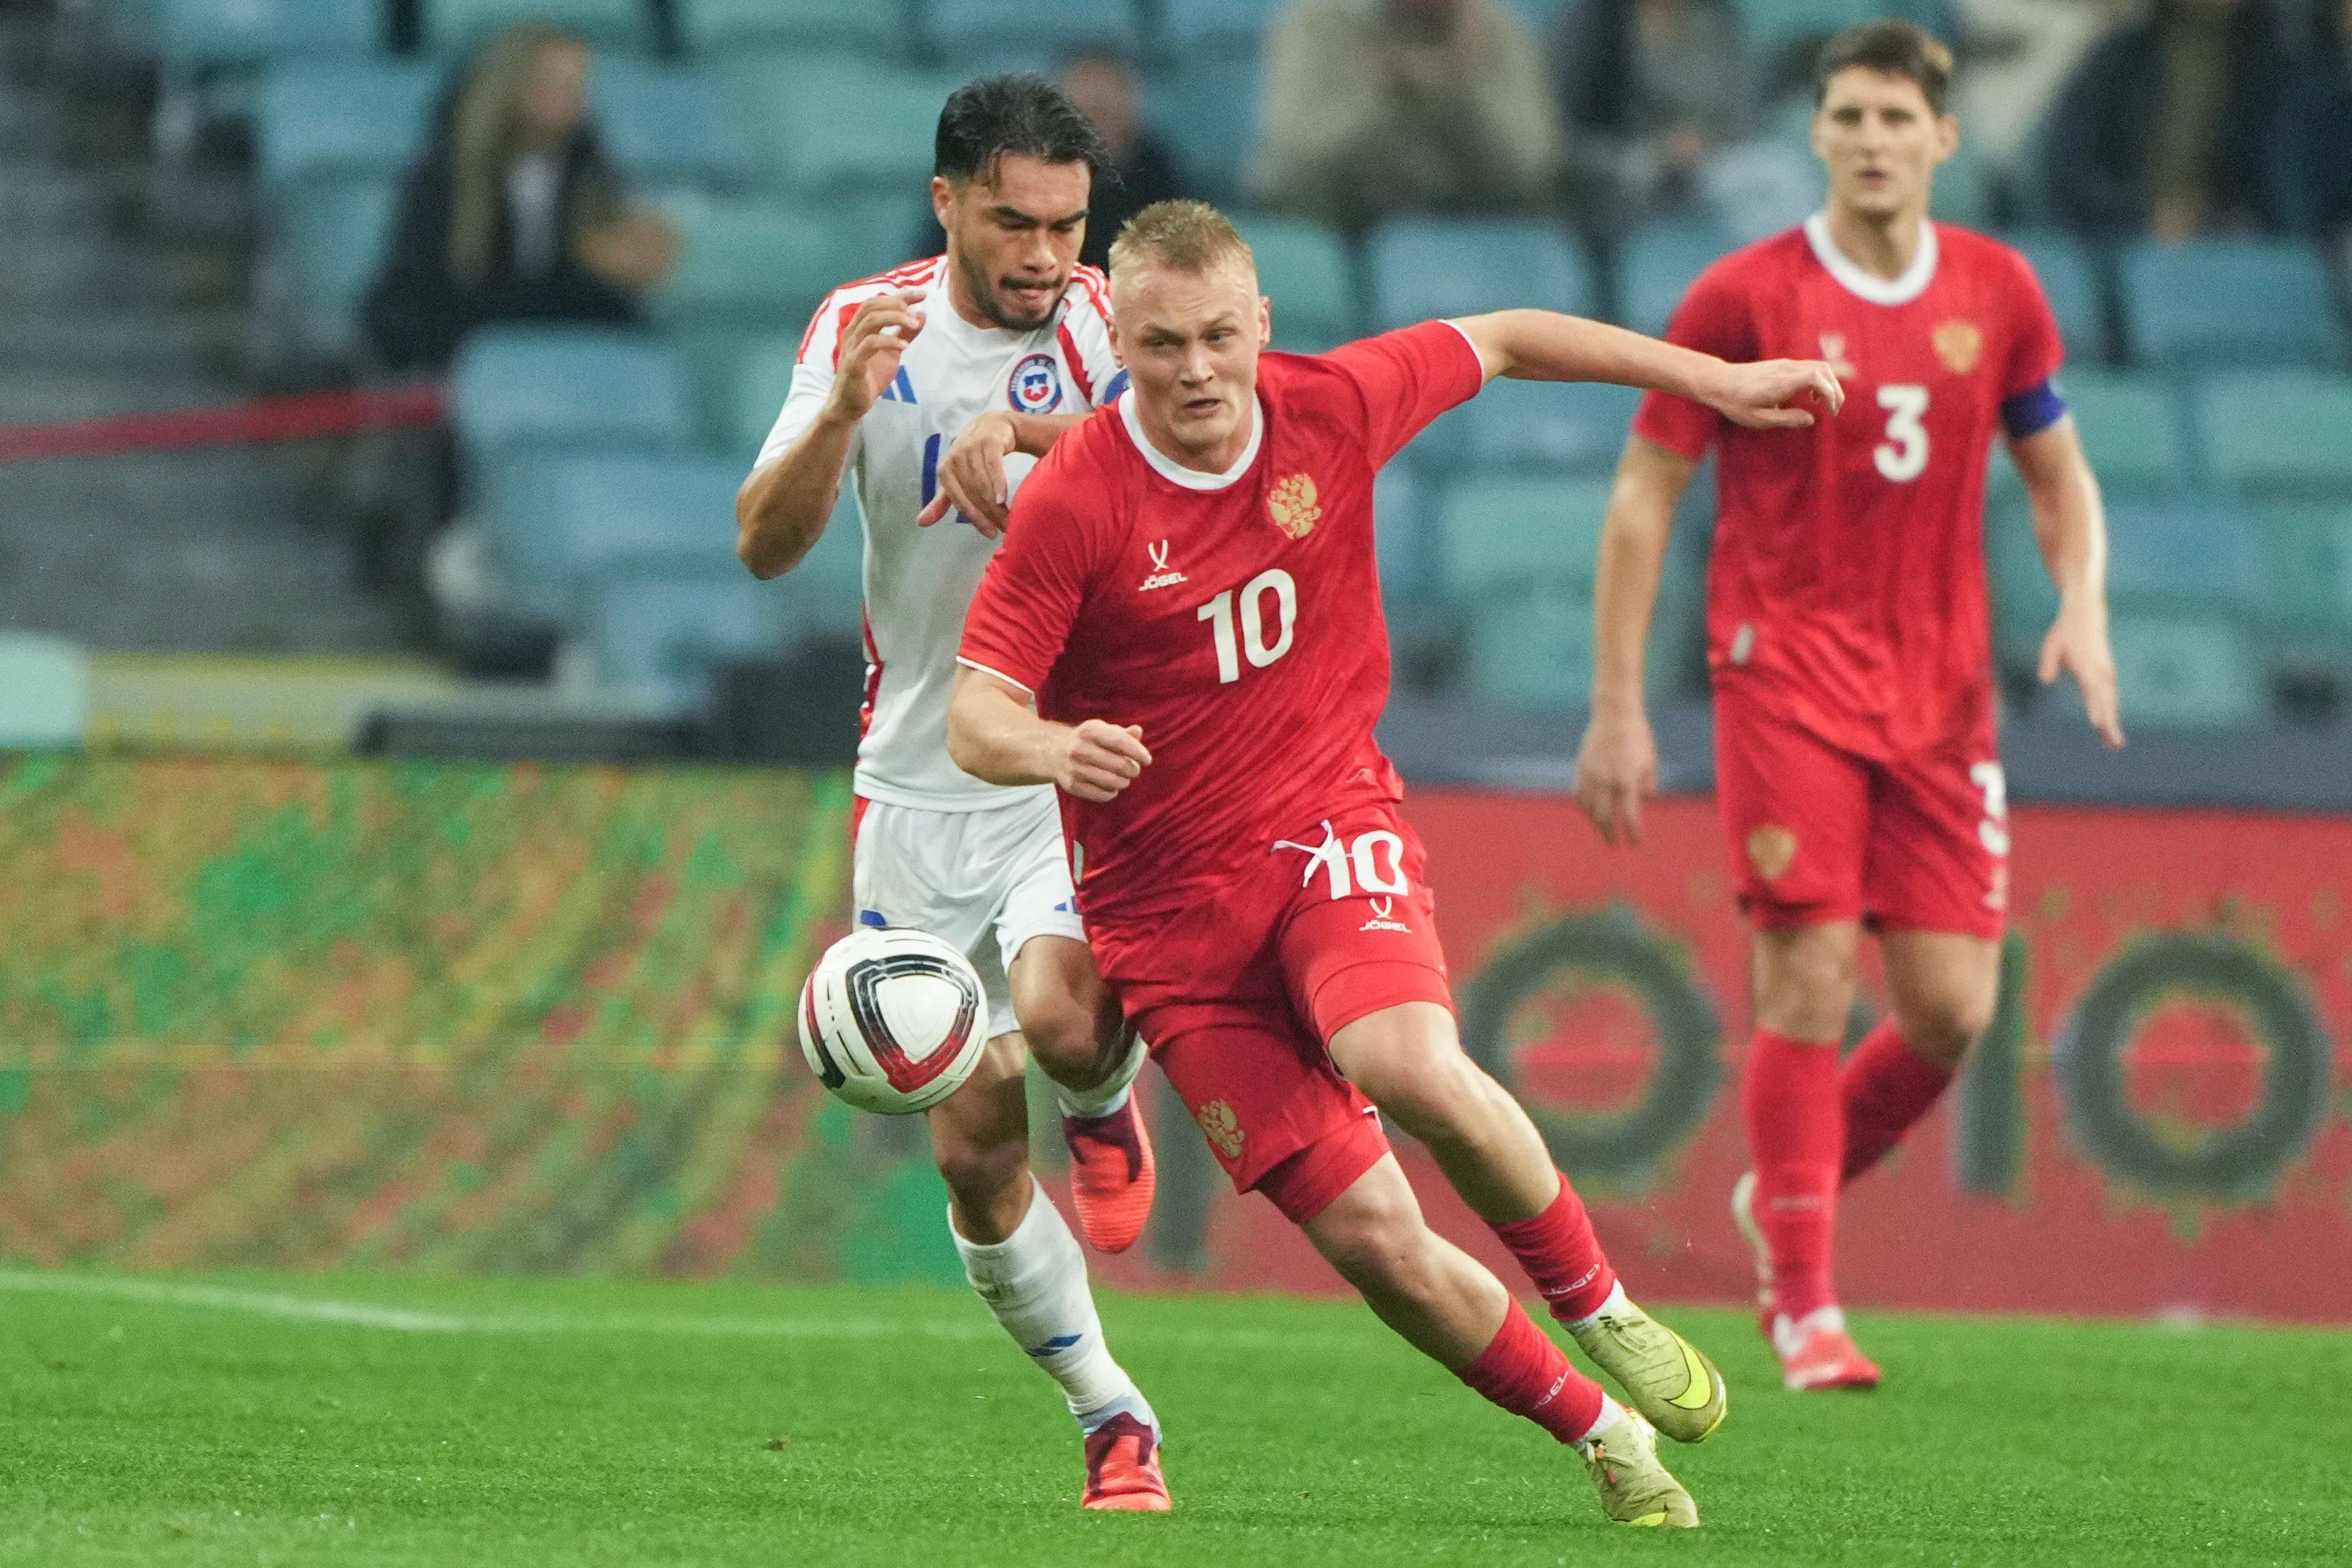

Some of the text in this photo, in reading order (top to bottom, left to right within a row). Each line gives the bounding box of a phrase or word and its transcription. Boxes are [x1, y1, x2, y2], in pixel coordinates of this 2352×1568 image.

[1874, 383, 1929, 482] 3
[1197, 568, 1297, 683] 10
[1324, 829, 1408, 900] 10
